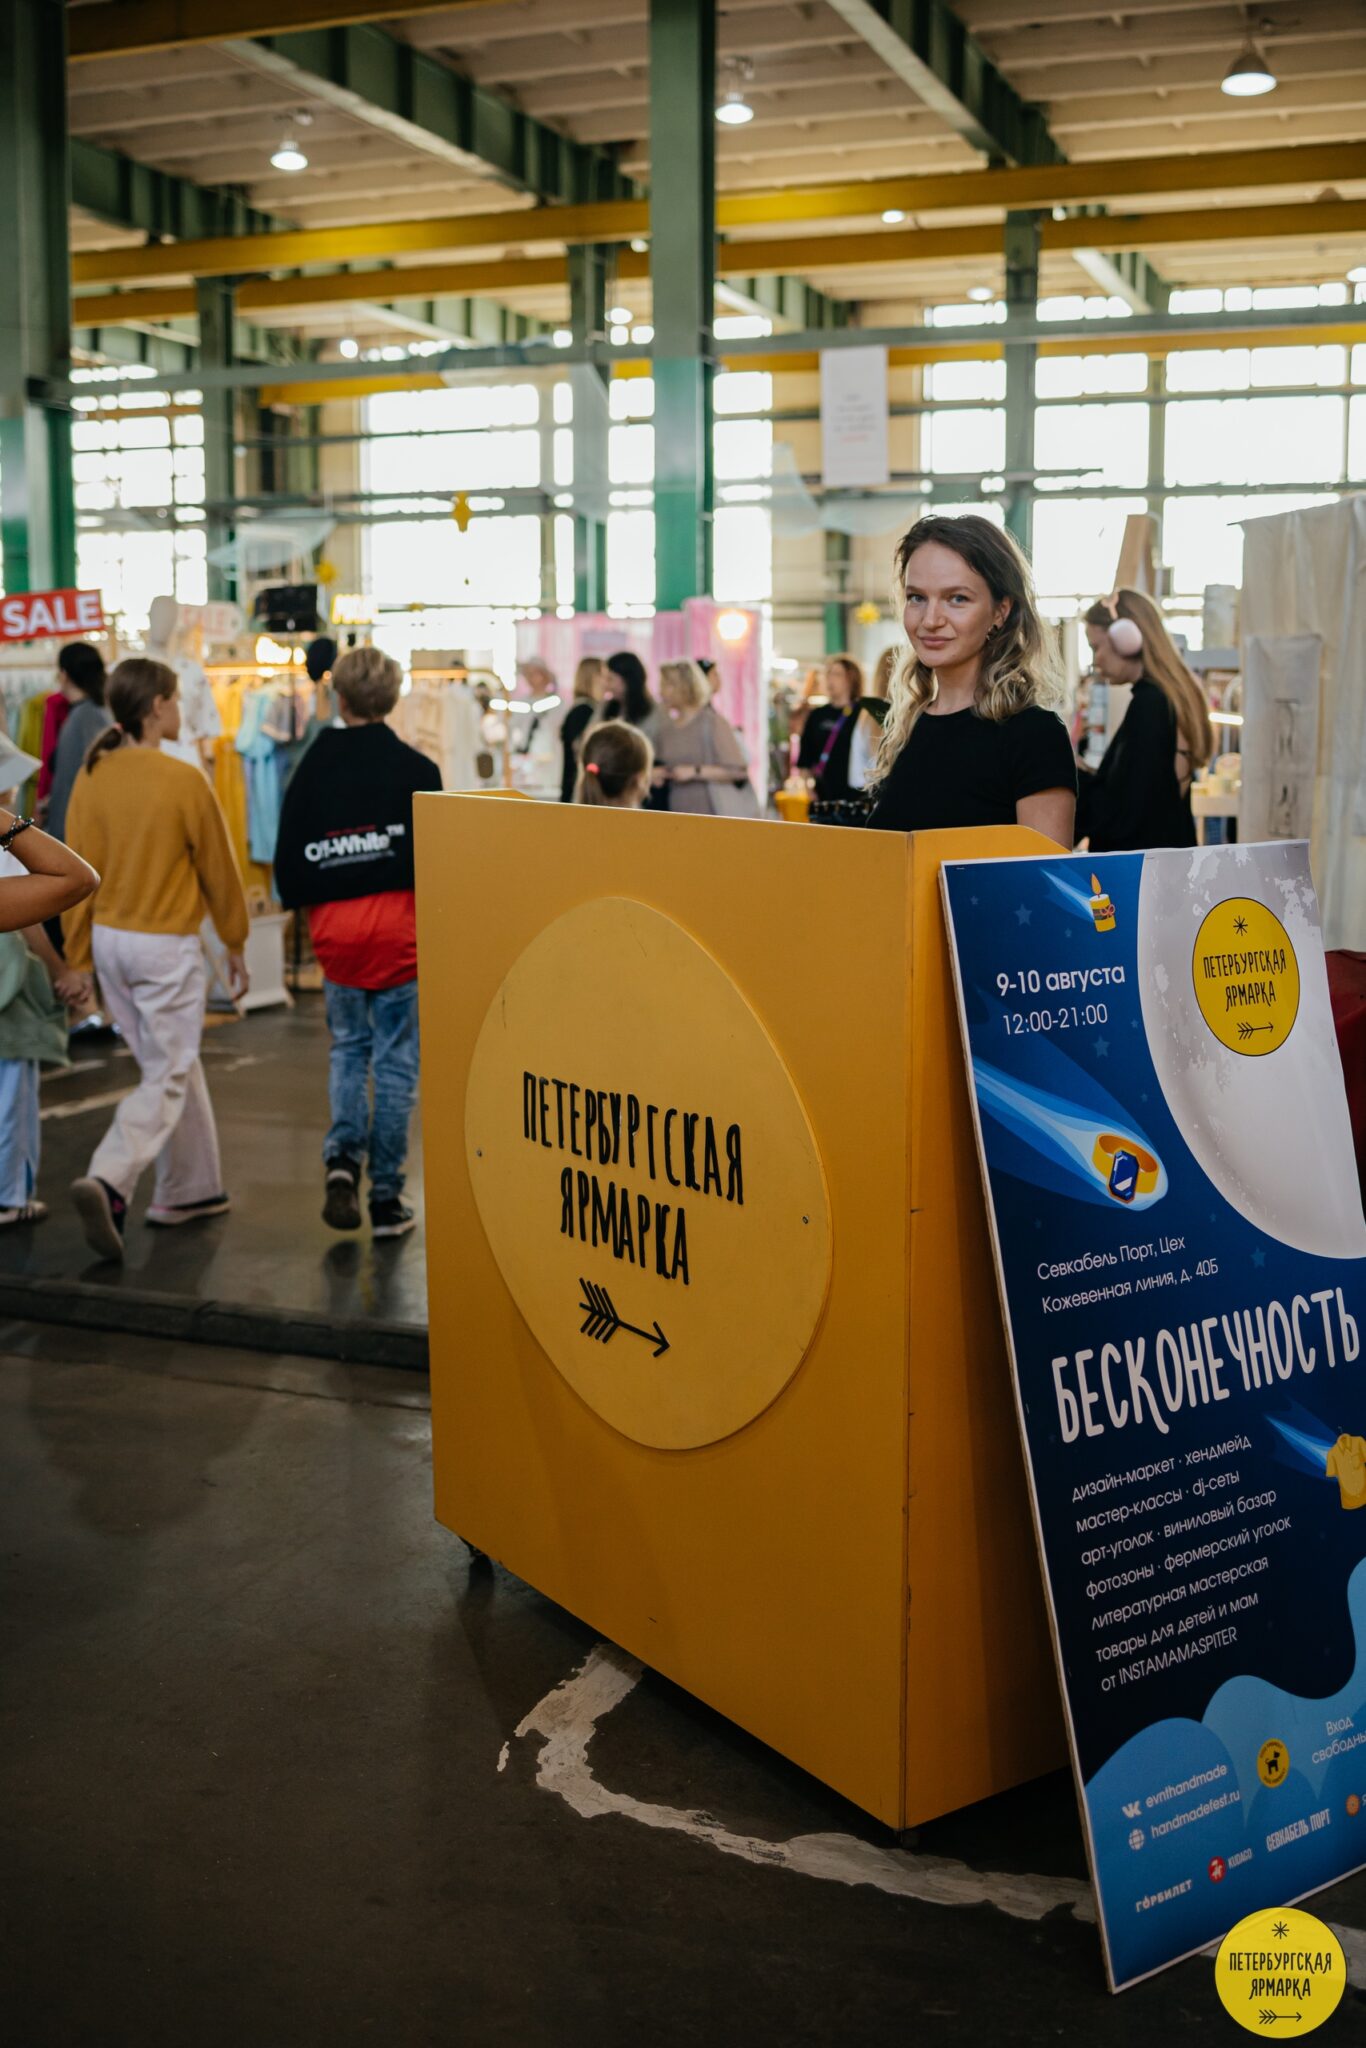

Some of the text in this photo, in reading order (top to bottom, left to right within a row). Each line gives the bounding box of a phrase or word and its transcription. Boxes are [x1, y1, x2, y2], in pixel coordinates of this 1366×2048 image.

[2, 594, 100, 637] SALE
[996, 965, 1126, 997] 9-10 августа
[1203, 948, 1287, 979] ПЕТЕРБУРГСКАЯ
[1003, 1003, 1108, 1035] 12:00-21:00
[1225, 980, 1277, 1013] ЯРМАРКА
[523, 1070, 744, 1205] ПЕТЕРБУРГСКАЯ
[560, 1166, 690, 1286] ЯРМАРКА
[1037, 1236, 1186, 1281] Севкабель Порт, Цех
[1042, 1258, 1219, 1314] Кожевенная линия, д. 40Б
[1051, 1286, 1361, 1444] БЕСКОНЕЧНОСТЬ
[1072, 1435, 1252, 1503] дизайн-маркет хендмейд
[1076, 1470, 1240, 1533] мастер-классы dj-сеты
[1081, 1489, 1277, 1566] арт-уголок виниловый базар
[1086, 1516, 1292, 1600] фотозоны фермерский уголок
[1091, 1556, 1269, 1631] литературная мастерская
[1096, 1592, 1259, 1662] товары для детей и мам
[1101, 1626, 1238, 1692] от INSTAMAMASPITER
[1311, 1731, 1366, 1764] свободны
[1326, 1717, 1354, 1736] Вход
[1145, 1764, 1228, 1808] evnthandmade
[1151, 1790, 1241, 1839] handmadefest.ru
